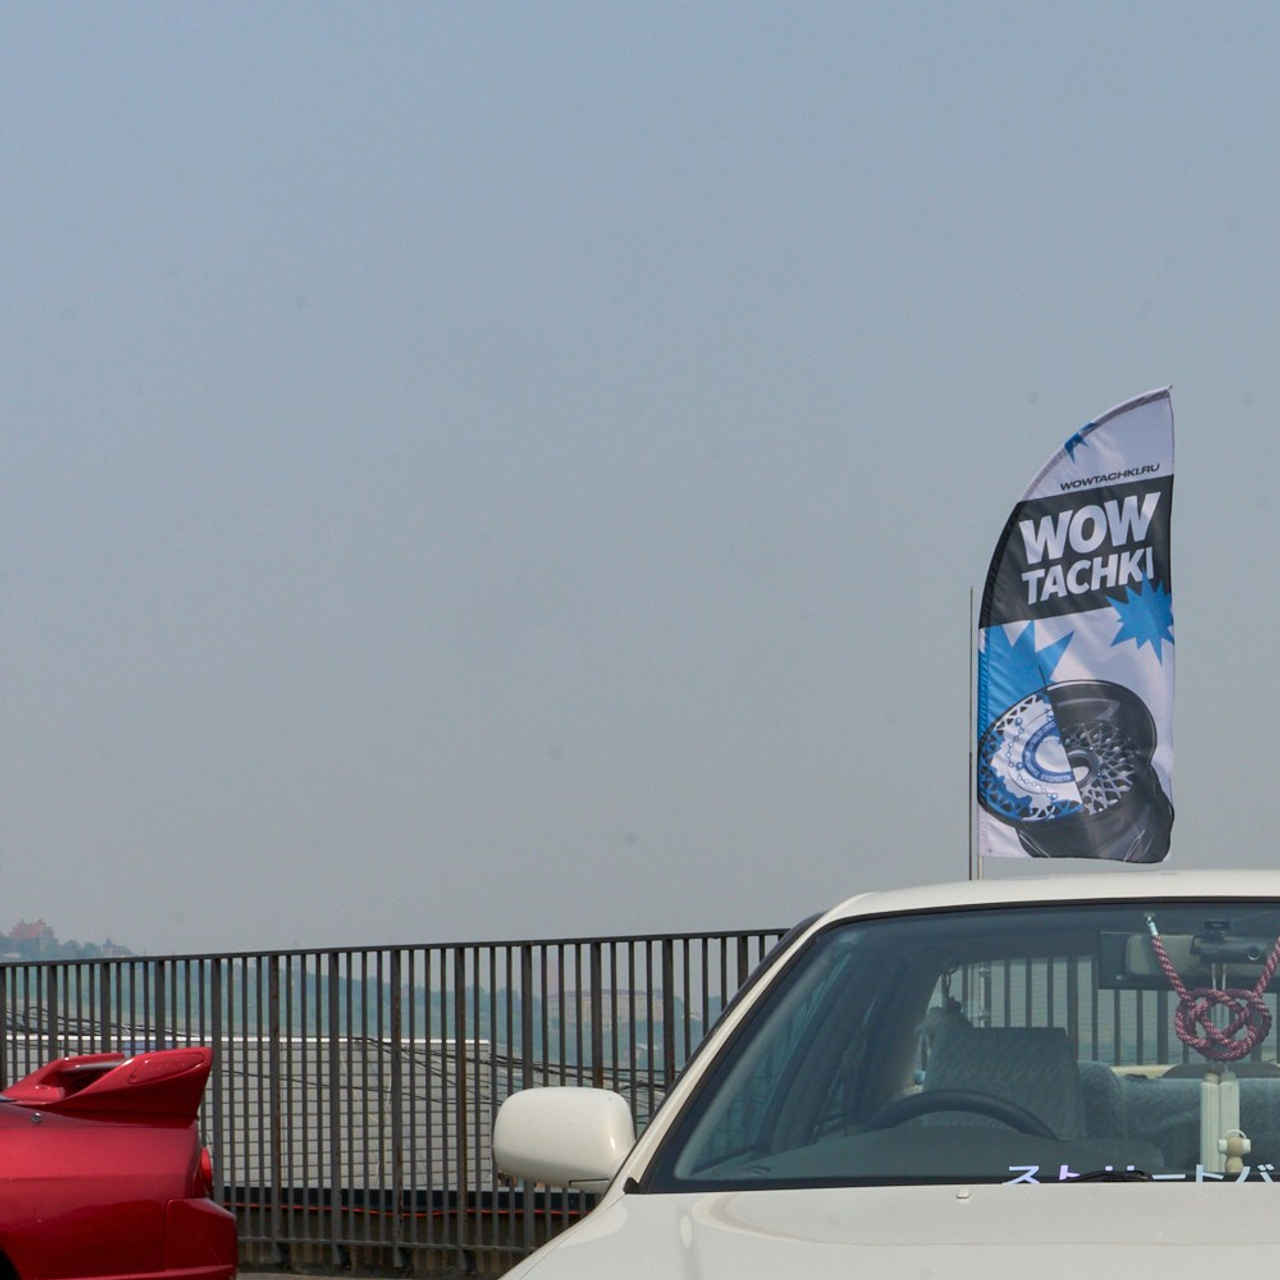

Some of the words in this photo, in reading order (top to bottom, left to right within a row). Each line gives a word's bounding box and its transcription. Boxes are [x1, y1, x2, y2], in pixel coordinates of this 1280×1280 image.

[1060, 463, 1161, 491] WOWTACHKI.RU
[1019, 492, 1161, 565] WOW
[1022, 546, 1154, 606] TACHKI
